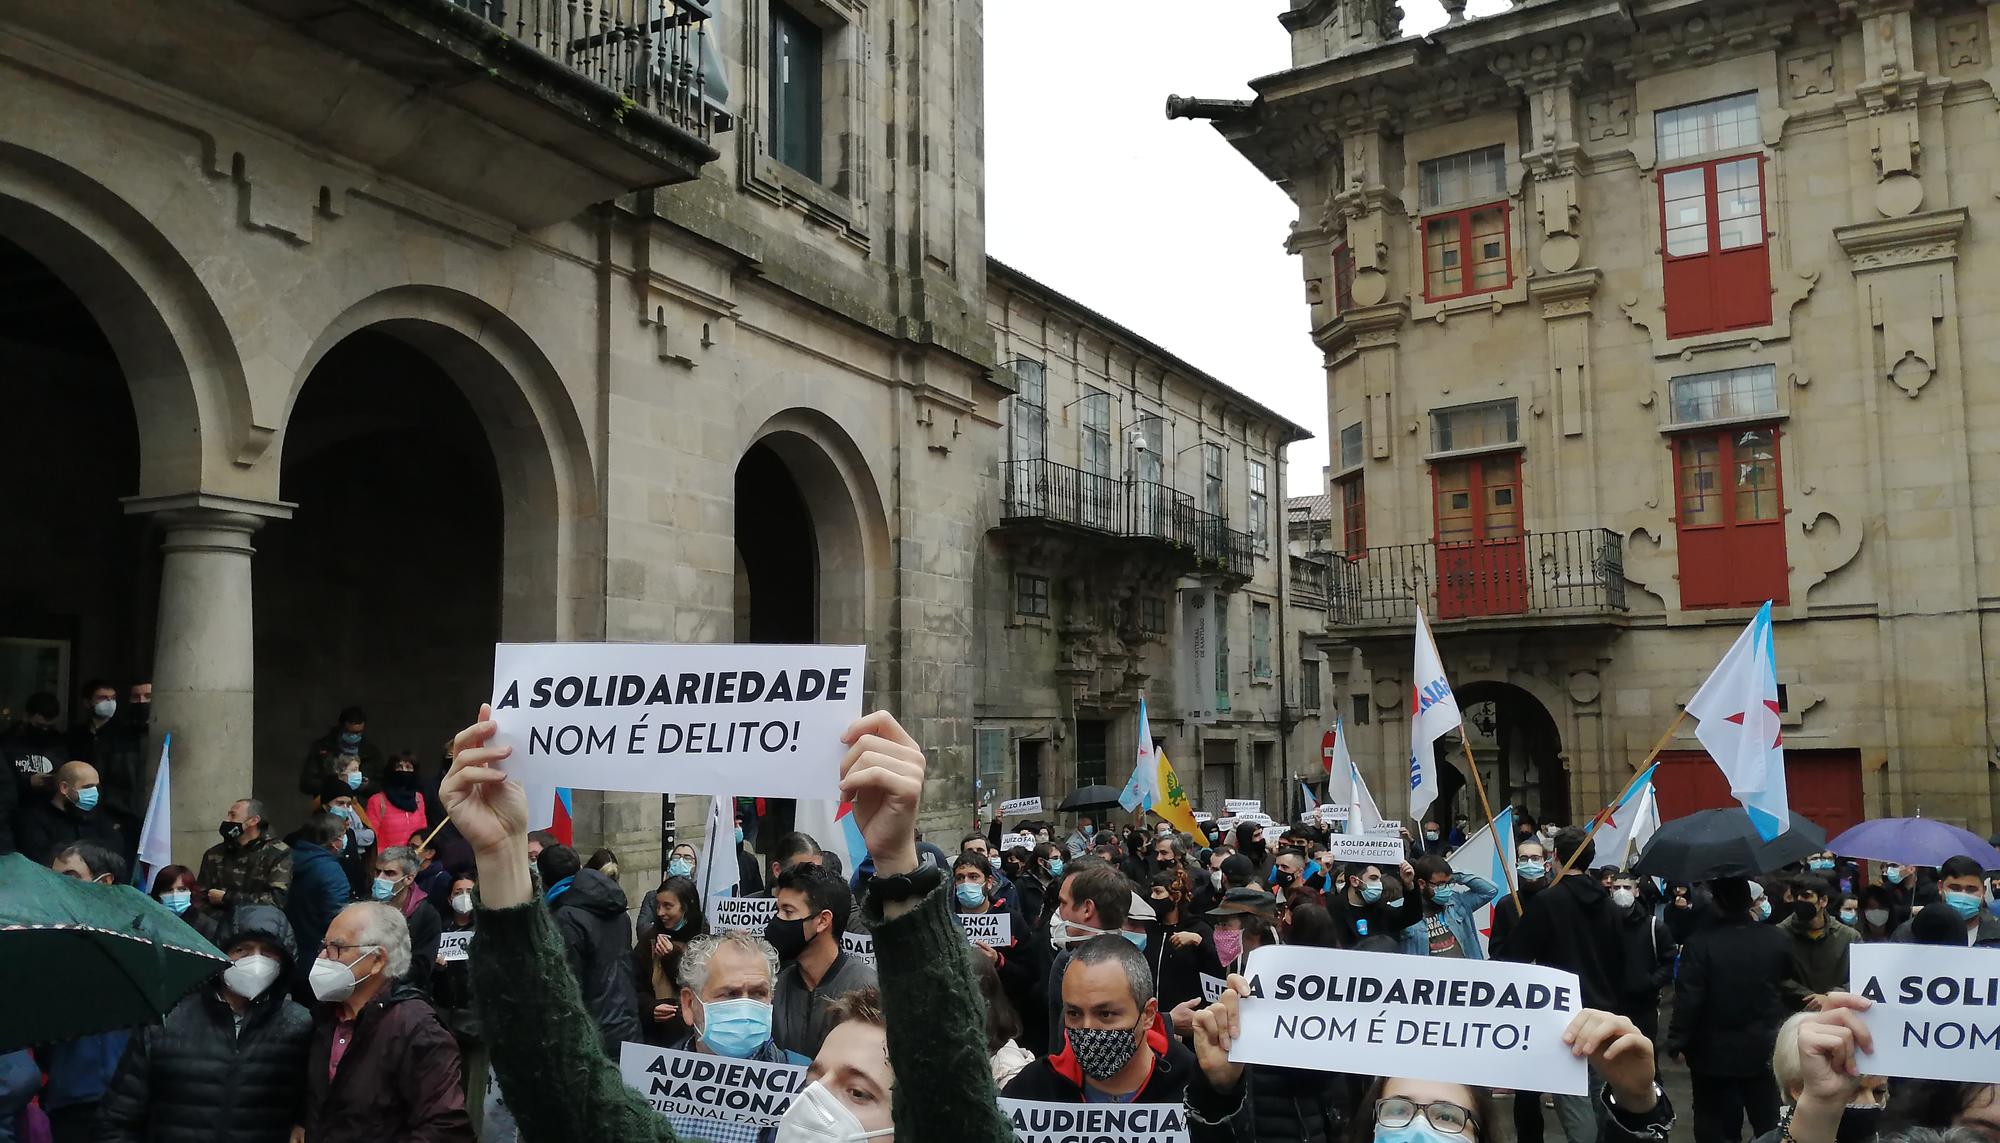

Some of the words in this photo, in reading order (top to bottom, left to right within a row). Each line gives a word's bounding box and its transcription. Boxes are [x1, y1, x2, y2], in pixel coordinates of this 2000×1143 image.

[496, 679, 520, 710] A
[529, 668, 852, 709] SOLIDARIEDADE
[529, 724, 617, 756] NOM
[627, 713, 650, 755] É
[657, 720, 801, 754] DELITO!
[717, 901, 779, 913] AUDIENCIA
[718, 913, 770, 926] NACIONA
[962, 916, 999, 926] ENCIA
[965, 927, 998, 937] ONAL
[1240, 973, 1265, 999] A
[1274, 974, 1571, 1012] SOLIDARIEDADE
[1861, 975, 1887, 1003] A
[1898, 976, 1999, 1006] SOLI
[1273, 1015, 1357, 1043] NOM
[1367, 1009, 1387, 1044] É
[1396, 1019, 1531, 1051] DELITO!
[1902, 1021, 2000, 1050] NOM
[649, 1077, 791, 1117] NACIONA
[1011, 1108, 1182, 1133] AUDIENCIA
